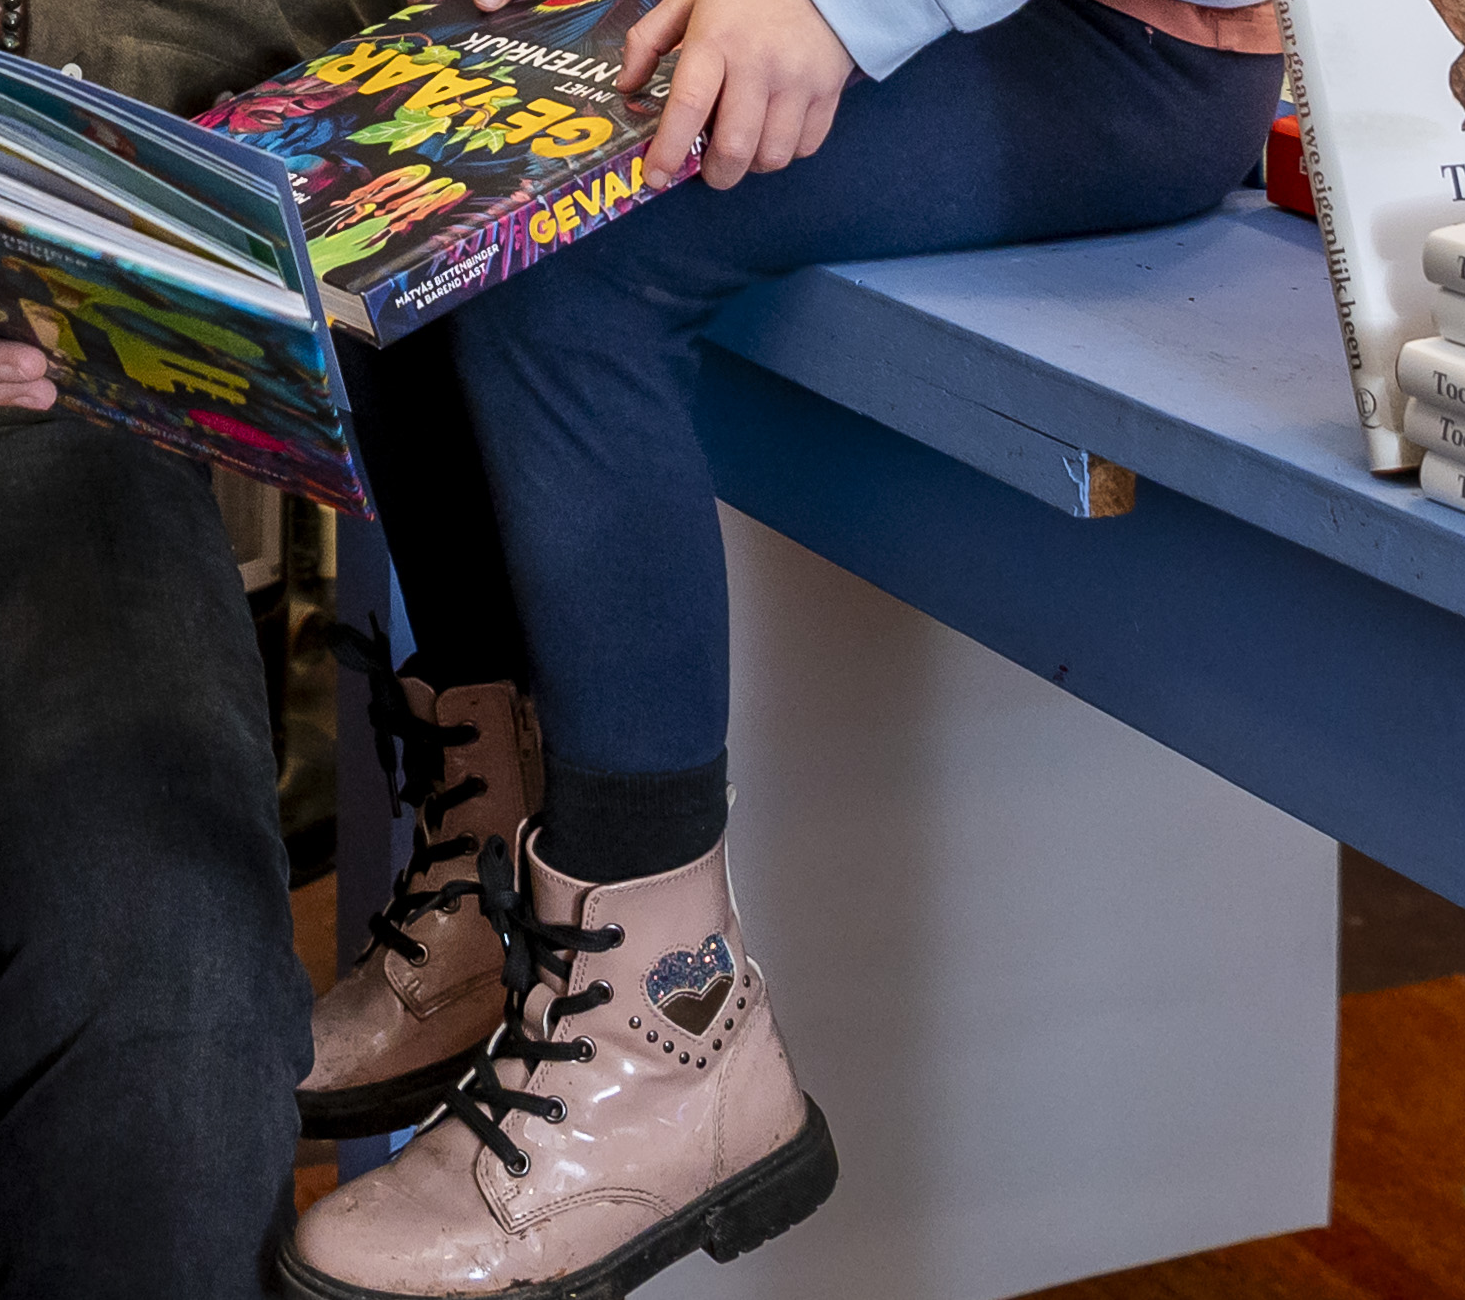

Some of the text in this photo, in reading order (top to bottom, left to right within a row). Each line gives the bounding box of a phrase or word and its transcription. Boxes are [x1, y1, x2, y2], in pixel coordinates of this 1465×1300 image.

[315, 39, 614, 161] GEVAAR
[553, 81, 614, 103] IN HET
[1282, 48, 1314, 119] gaan
[1303, 122, 1323, 163] we
[1311, 159, 1353, 297] eigenlijk
[395, 243, 501, 309] MÁTYÁS BITTENBINDER
[423, 275, 463, 306] BAREND
[462, 262, 487, 287] LAST
[1333, 297, 1365, 372] heen
